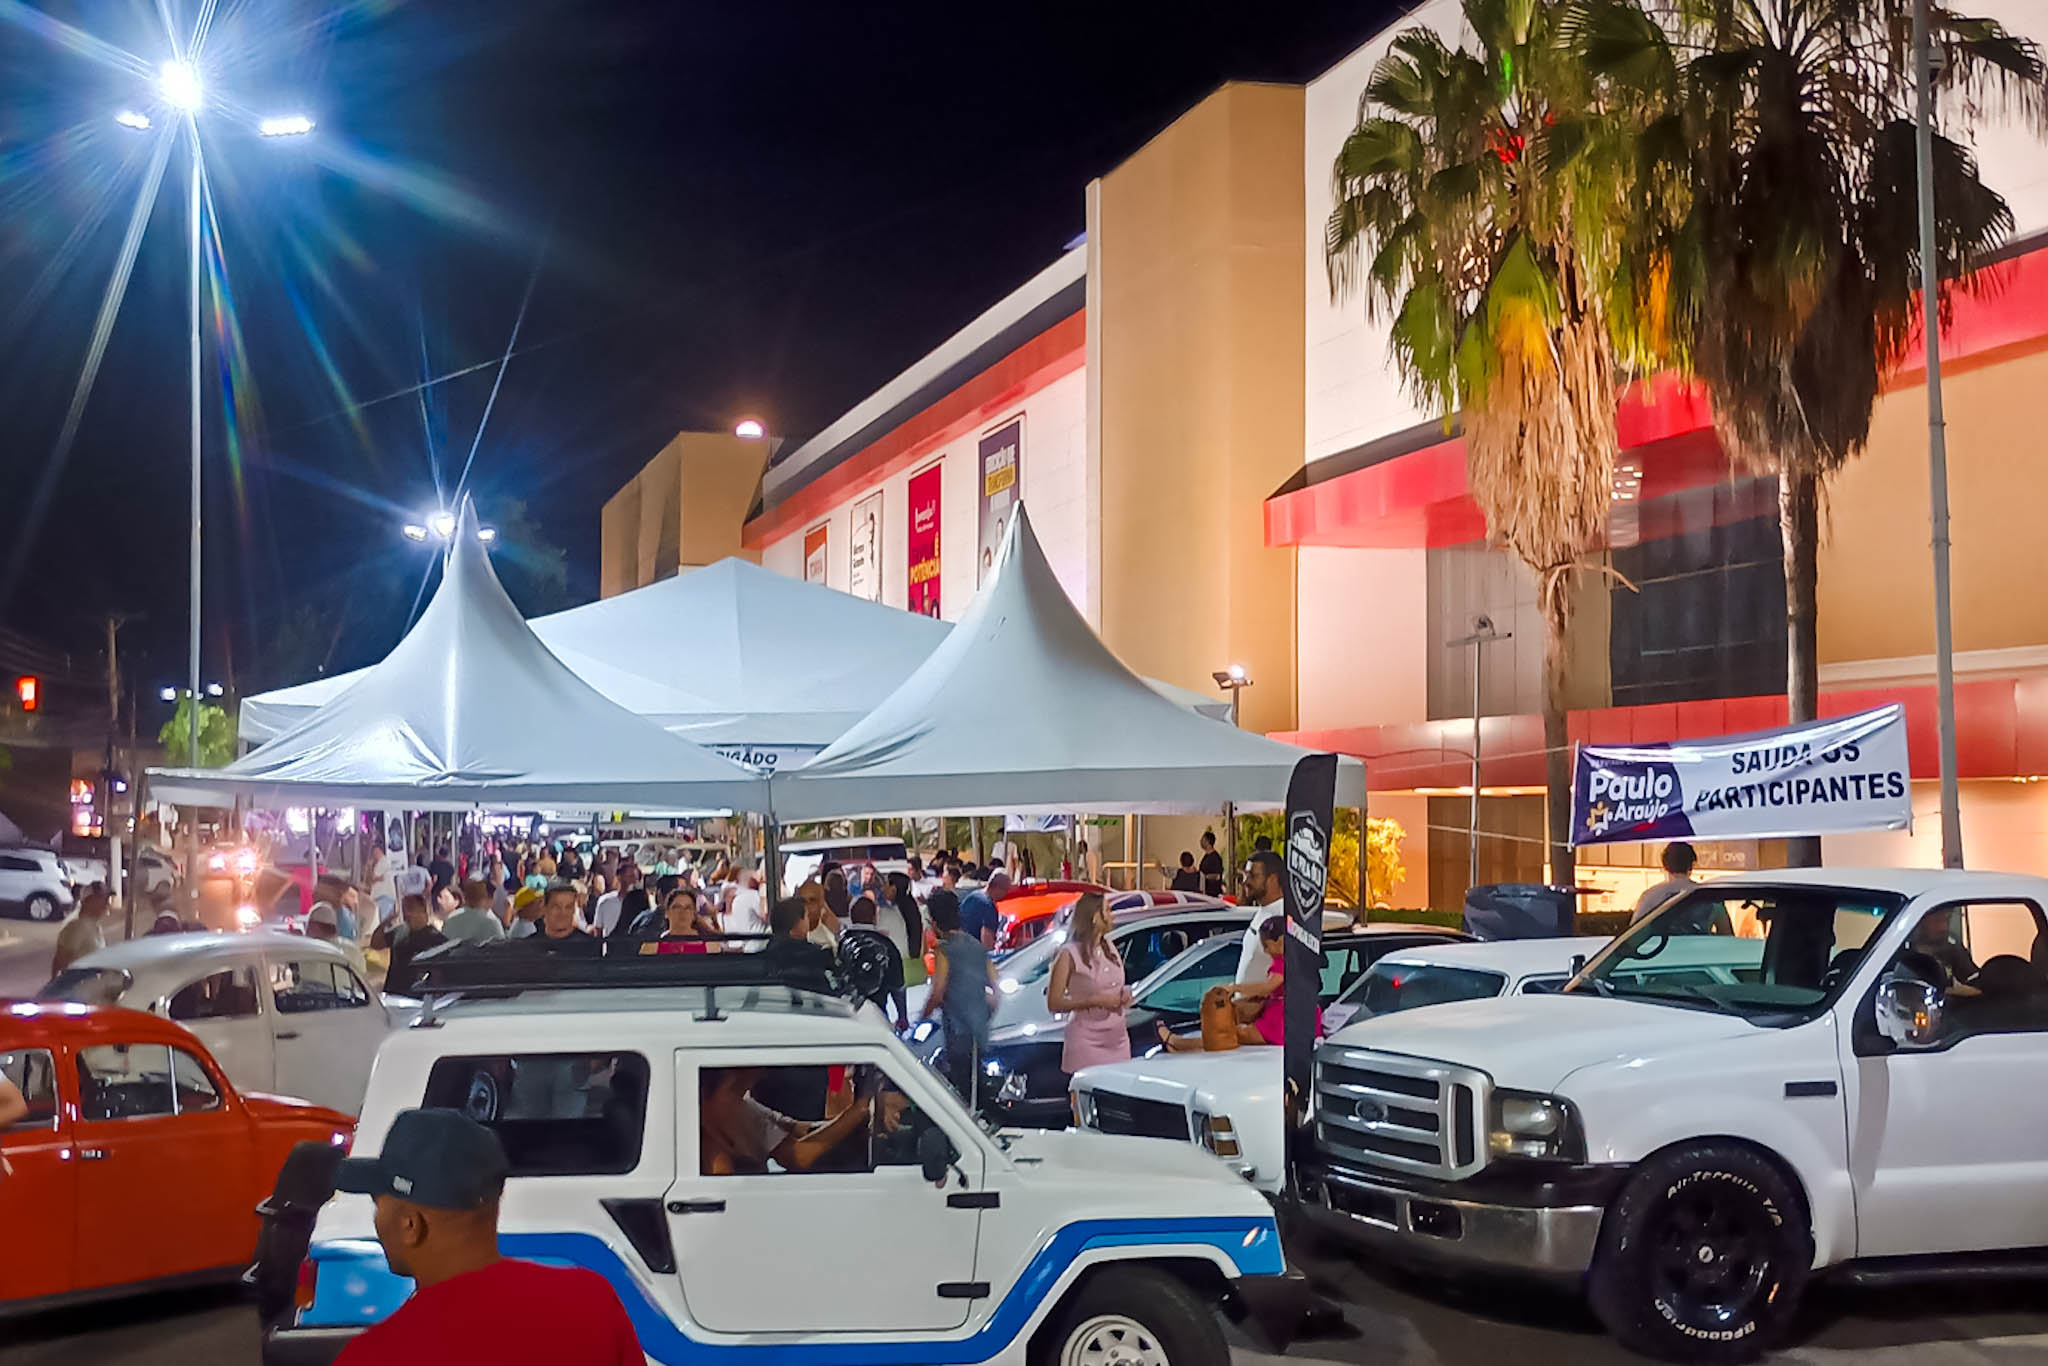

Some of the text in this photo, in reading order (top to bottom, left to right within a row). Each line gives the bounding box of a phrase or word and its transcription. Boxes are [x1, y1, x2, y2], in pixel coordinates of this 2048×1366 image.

[1589, 767, 1673, 803] Paulo
[1695, 771, 1905, 812] PARTICIPANTES
[1614, 799, 1670, 824] Araújo
